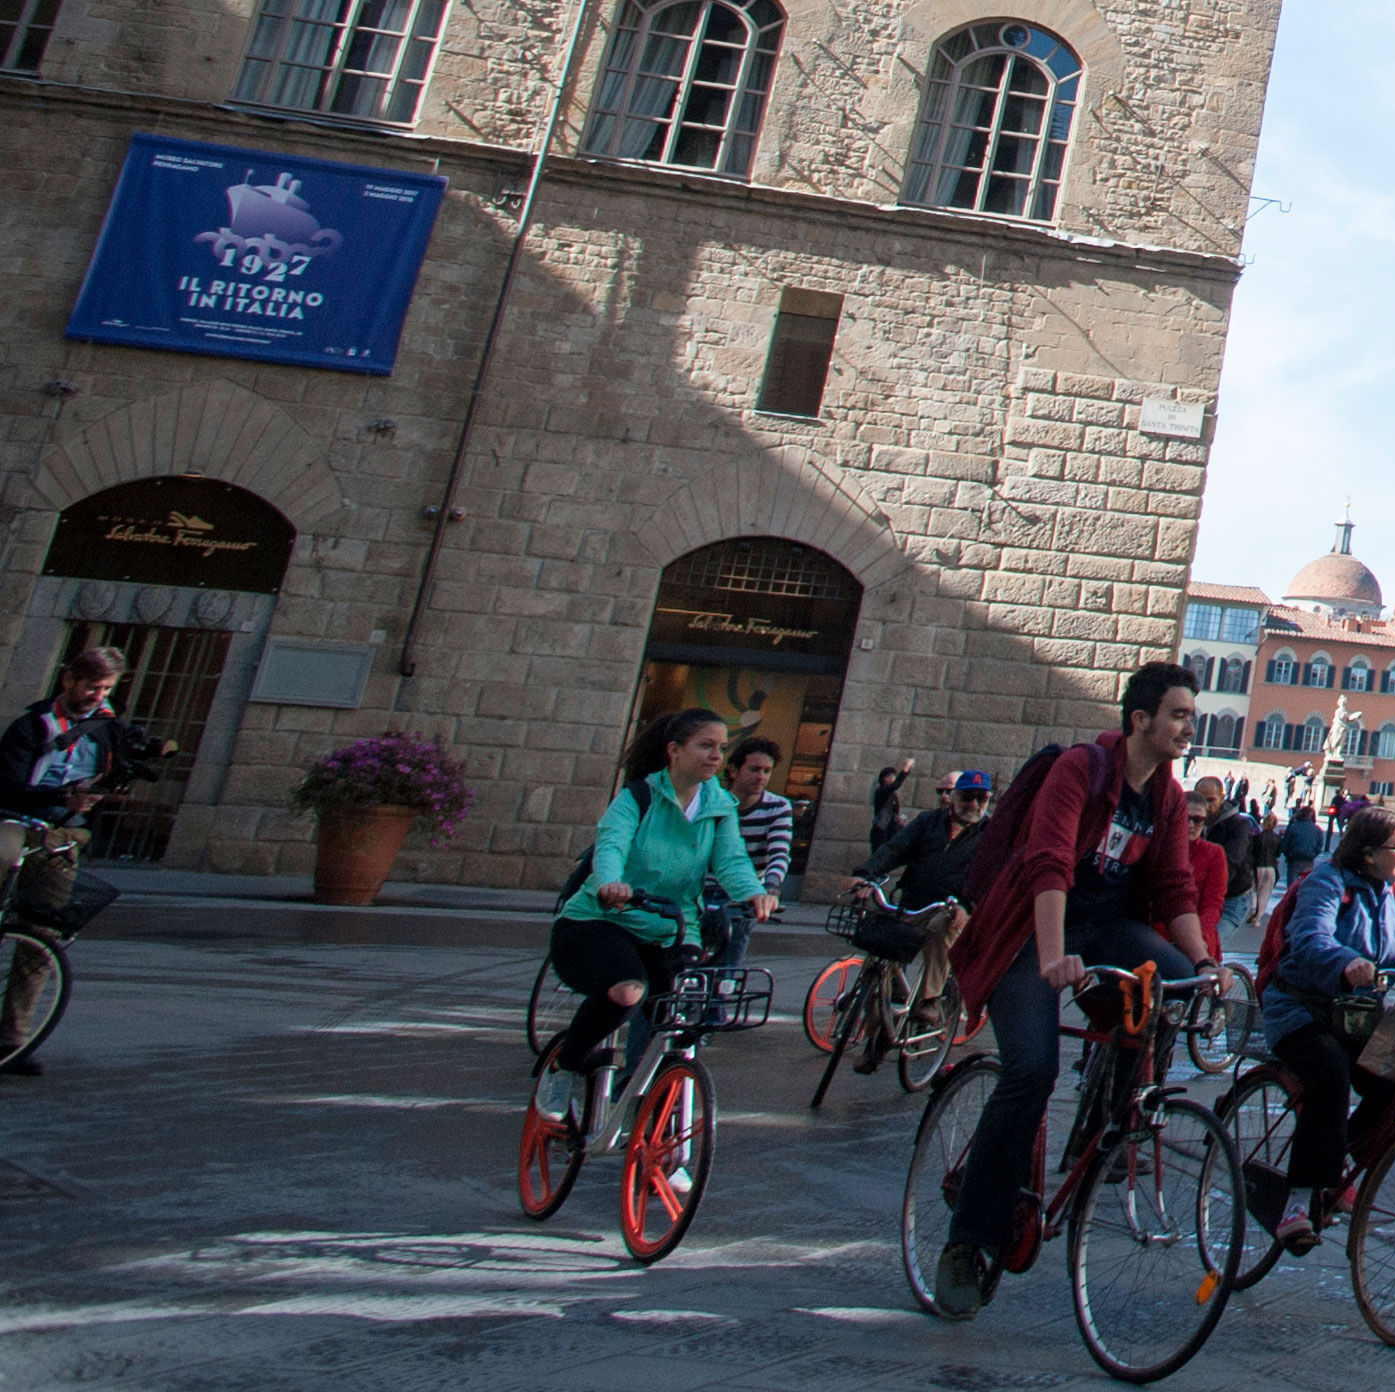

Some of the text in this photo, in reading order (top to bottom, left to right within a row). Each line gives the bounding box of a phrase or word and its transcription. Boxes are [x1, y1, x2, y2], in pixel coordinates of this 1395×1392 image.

[218, 247, 312, 283] 1927
[177, 275, 325, 308] IL RITORNO
[188, 292, 306, 321] IN ITALIA
[1158, 404, 1187, 414] PIAZZA
[1140, 421, 1166, 430] SANTA
[104, 524, 258, 558] Salvatore Ferragamo
[745, 617, 820, 646] Ferragamo
